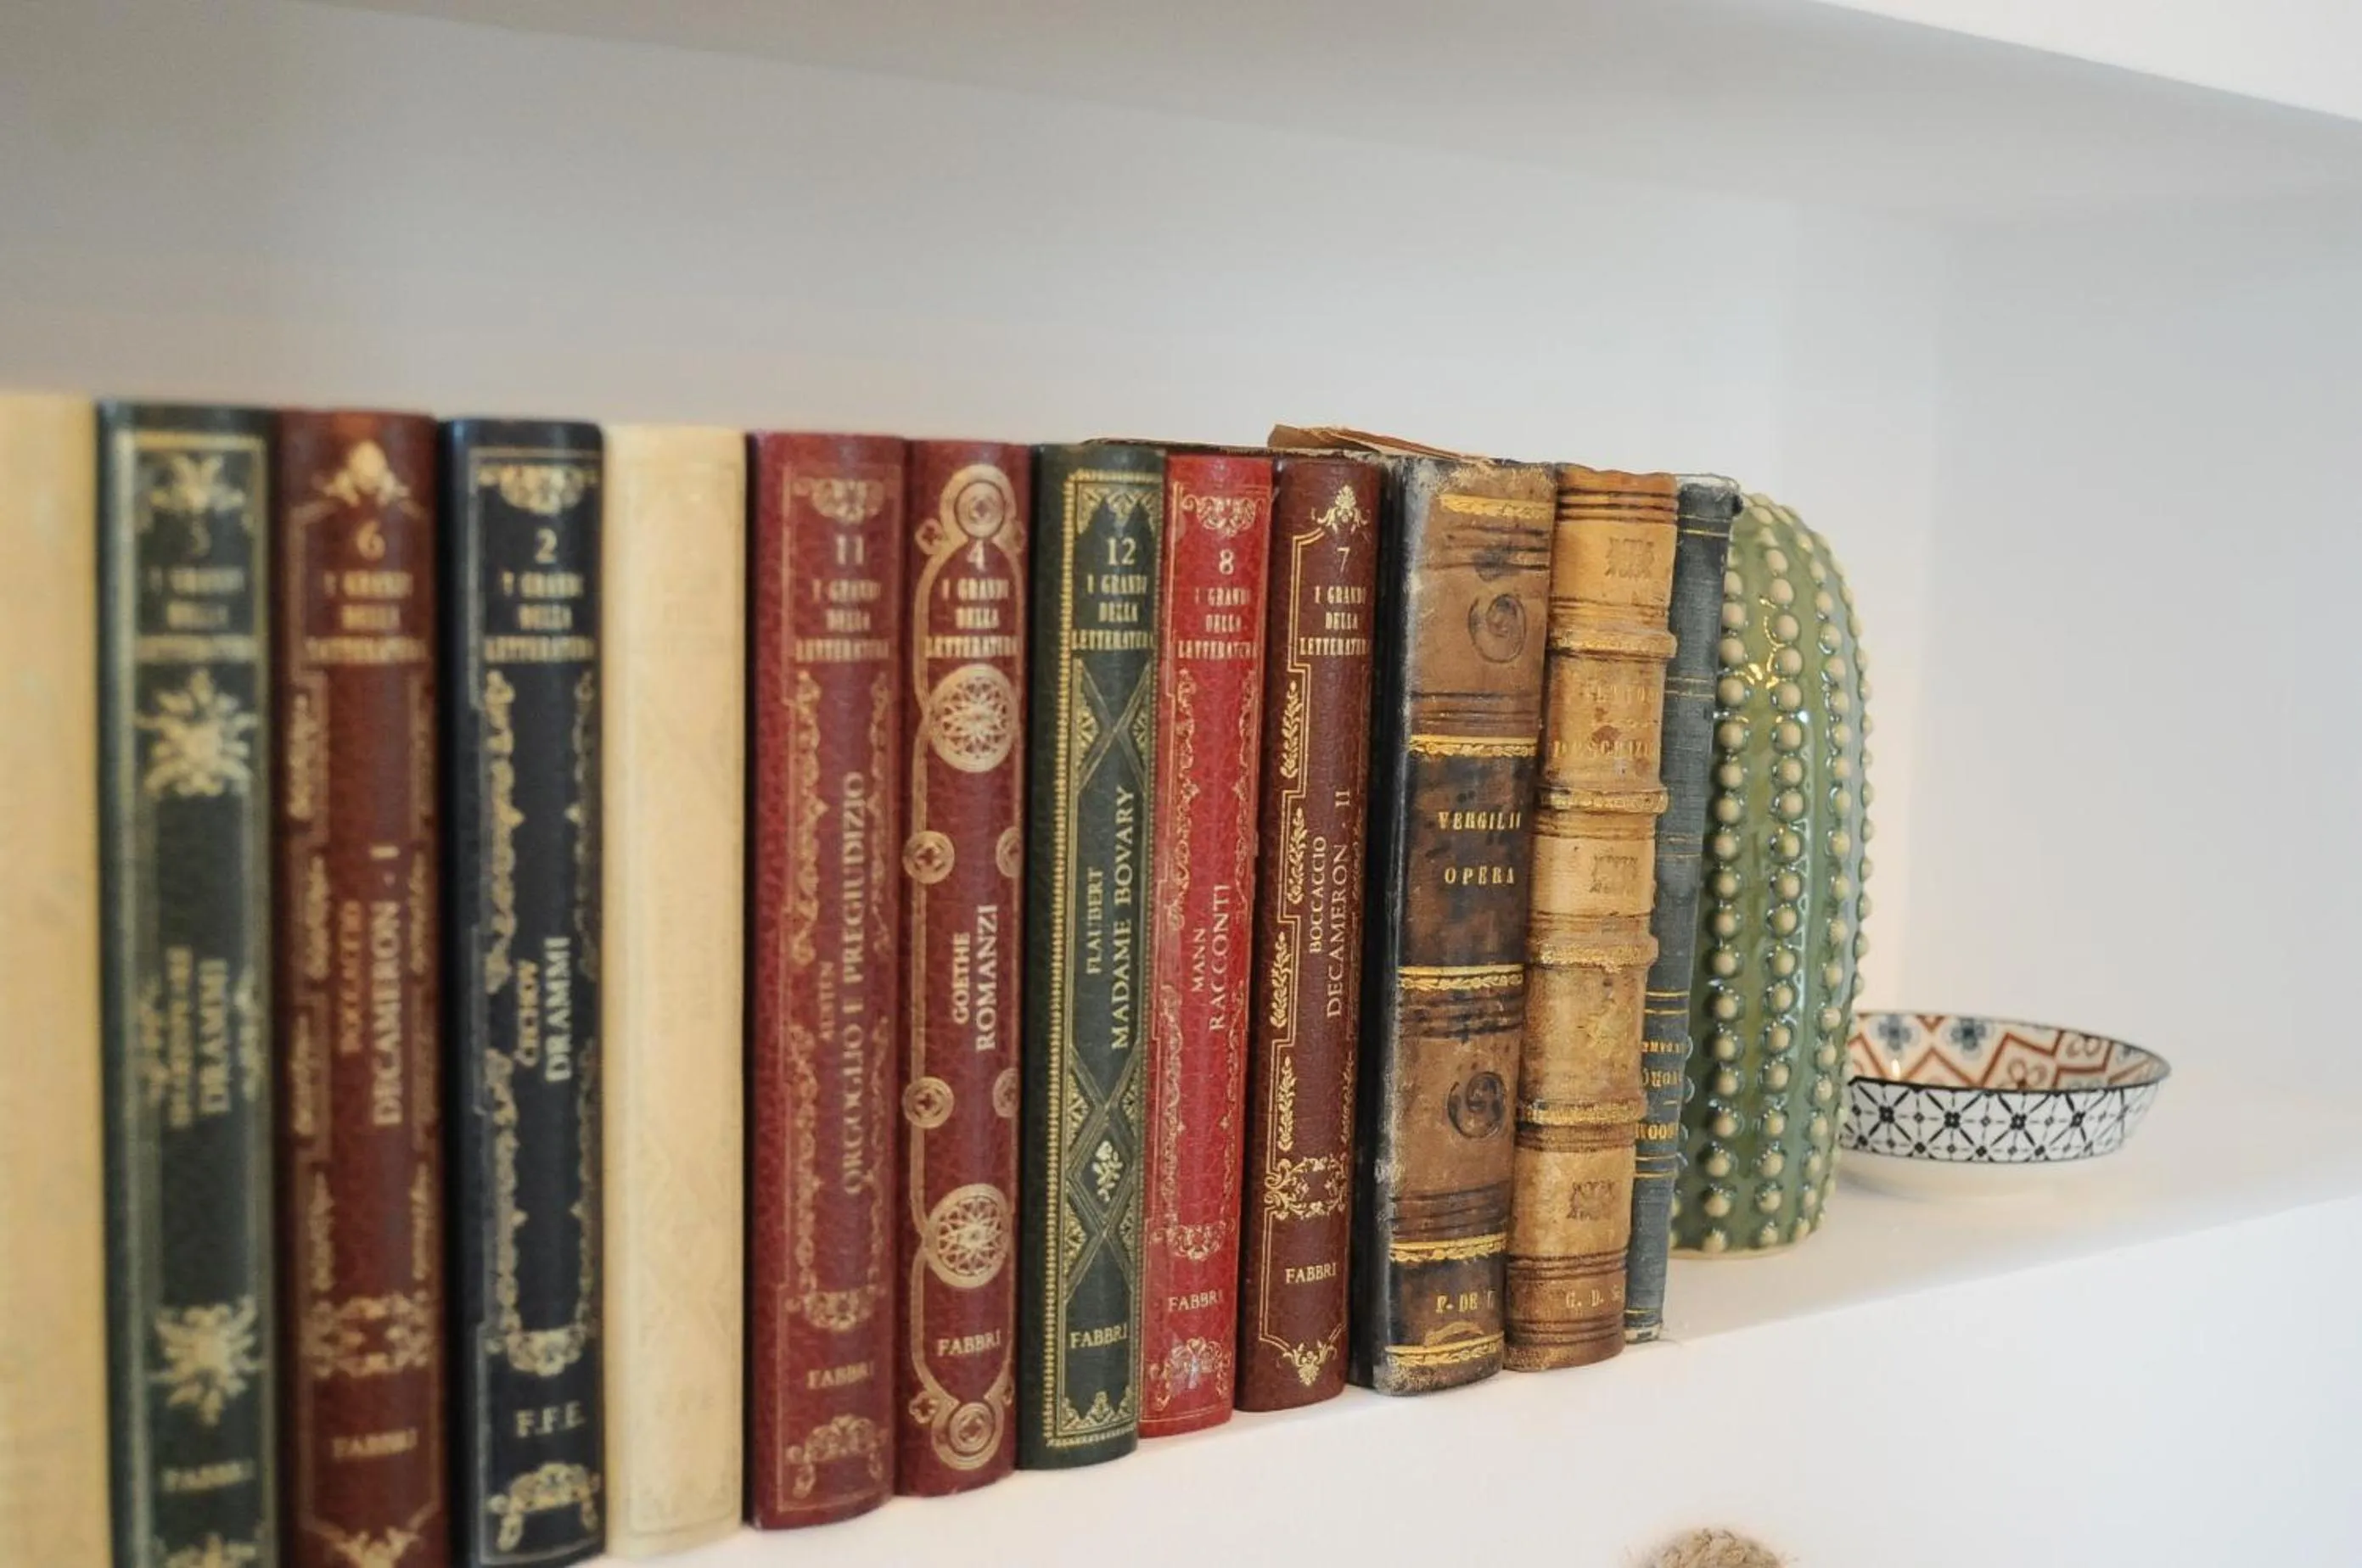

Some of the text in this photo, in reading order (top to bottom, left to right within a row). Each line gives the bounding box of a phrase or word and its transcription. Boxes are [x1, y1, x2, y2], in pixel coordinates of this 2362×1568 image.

[356, 519, 386, 560] 6
[534, 528, 558, 563] 2
[836, 534, 865, 566] 11
[967, 540, 986, 572] 4
[1107, 536, 1137, 566] 12
[1336, 546, 1351, 573] 7
[1219, 548, 1234, 575] 8
[843, 771, 867, 984] PREGIUDIZIO
[1310, 836, 1327, 954] BOCCACCIO
[1445, 865, 1515, 886] OPERA
[1086, 867, 1103, 975] FLAUBERT
[1111, 786, 1135, 1050] MADAME BOVARY
[1327, 843, 1351, 1018] DECAMERON
[1191, 927, 1207, 994] MANN
[1209, 883, 1231, 1031] RACCONTI
[952, 931, 970, 1025] GOETHE
[974, 904, 999, 1053] ROMANZI
[544, 936, 573, 1083] DRAMMI
[843, 1022, 864, 1196] ORGOGLIO
[1284, 1262, 1338, 1285] FABBRI
[1168, 1289, 1224, 1313] FABBRI
[937, 1329, 1002, 1358] FABBRI
[1070, 1323, 1128, 1349] FABBRI
